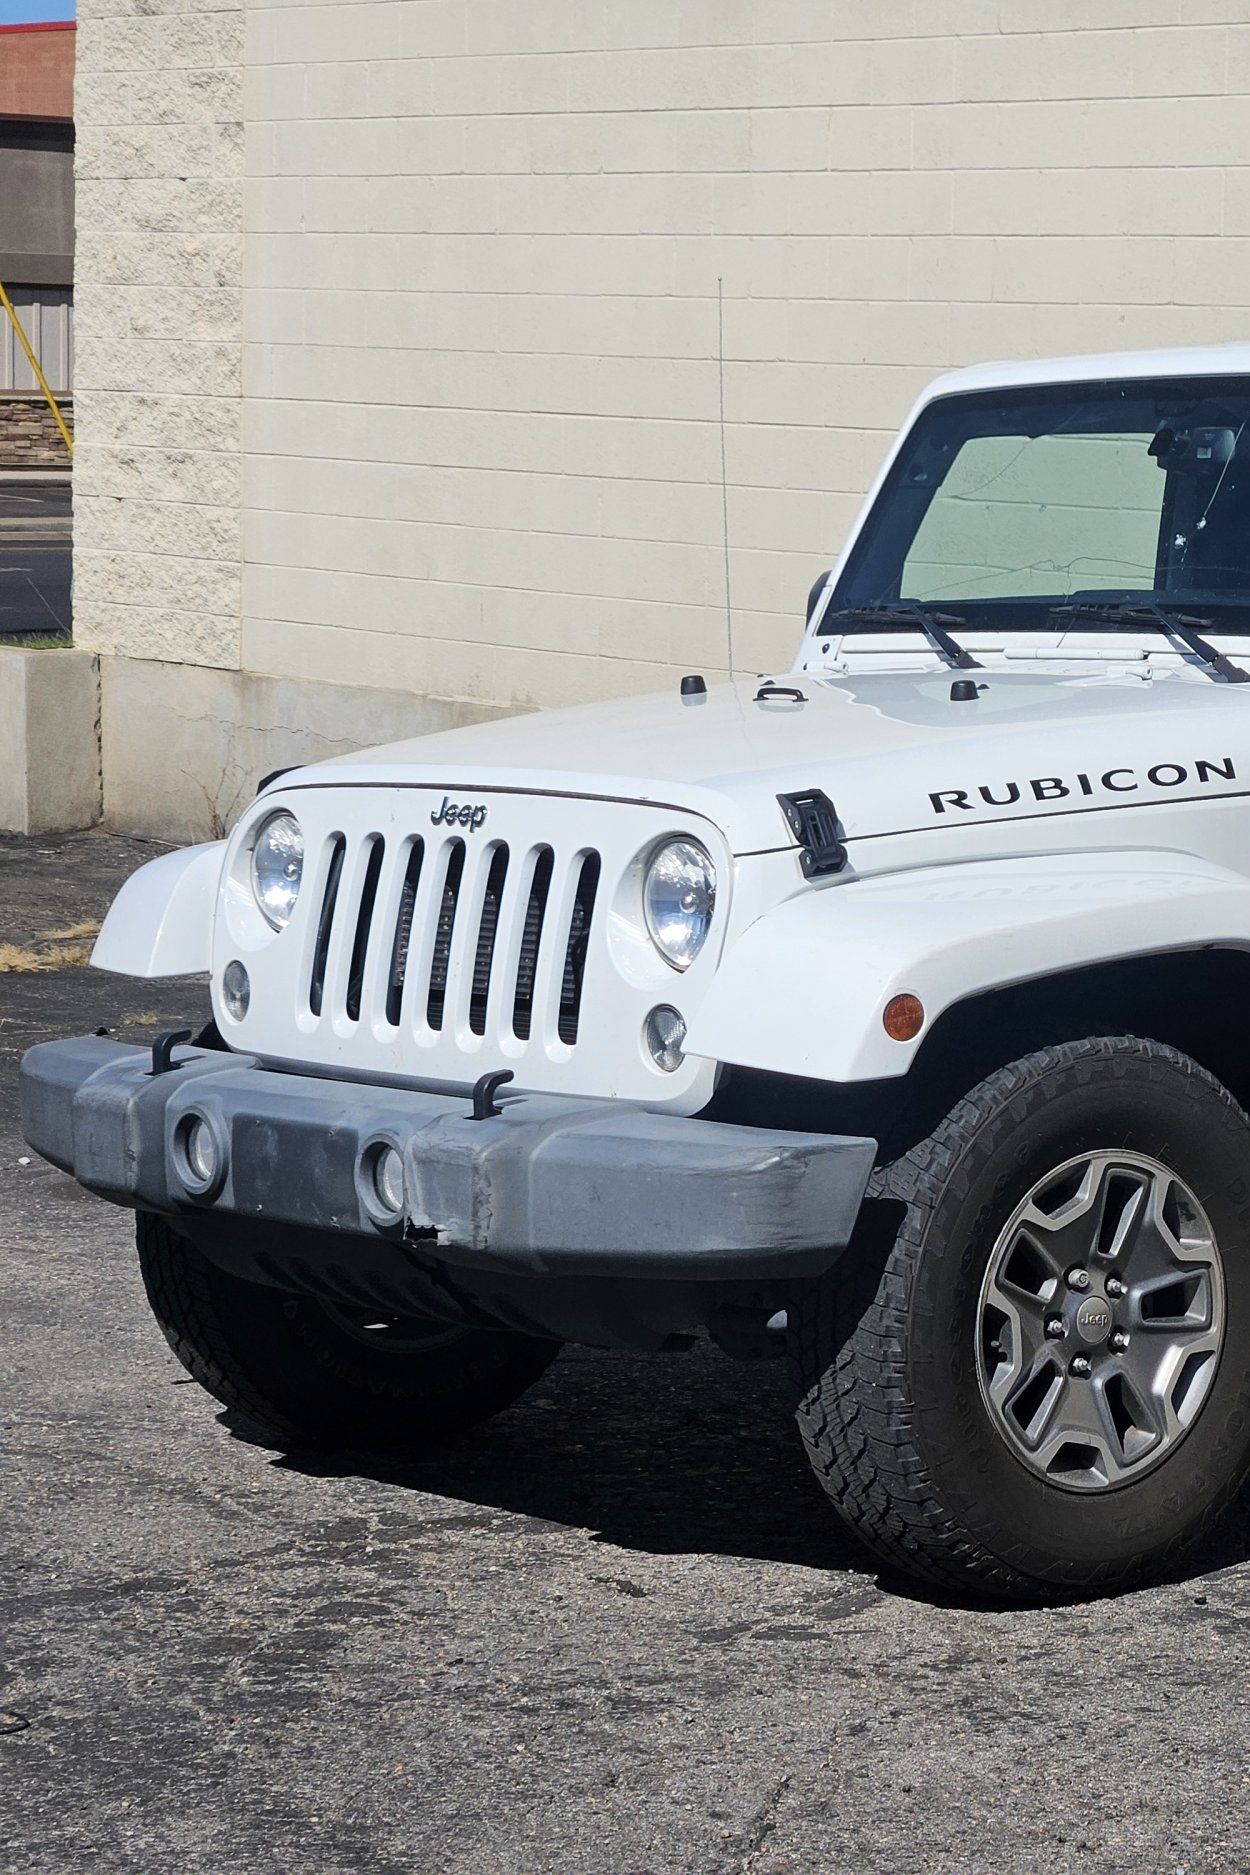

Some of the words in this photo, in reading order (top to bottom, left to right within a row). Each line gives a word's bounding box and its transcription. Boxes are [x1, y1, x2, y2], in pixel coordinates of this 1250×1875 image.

[928, 757, 1237, 814] RUBICON
[430, 796, 489, 833] Jeep
[1080, 1312, 1108, 1327] Jeep
